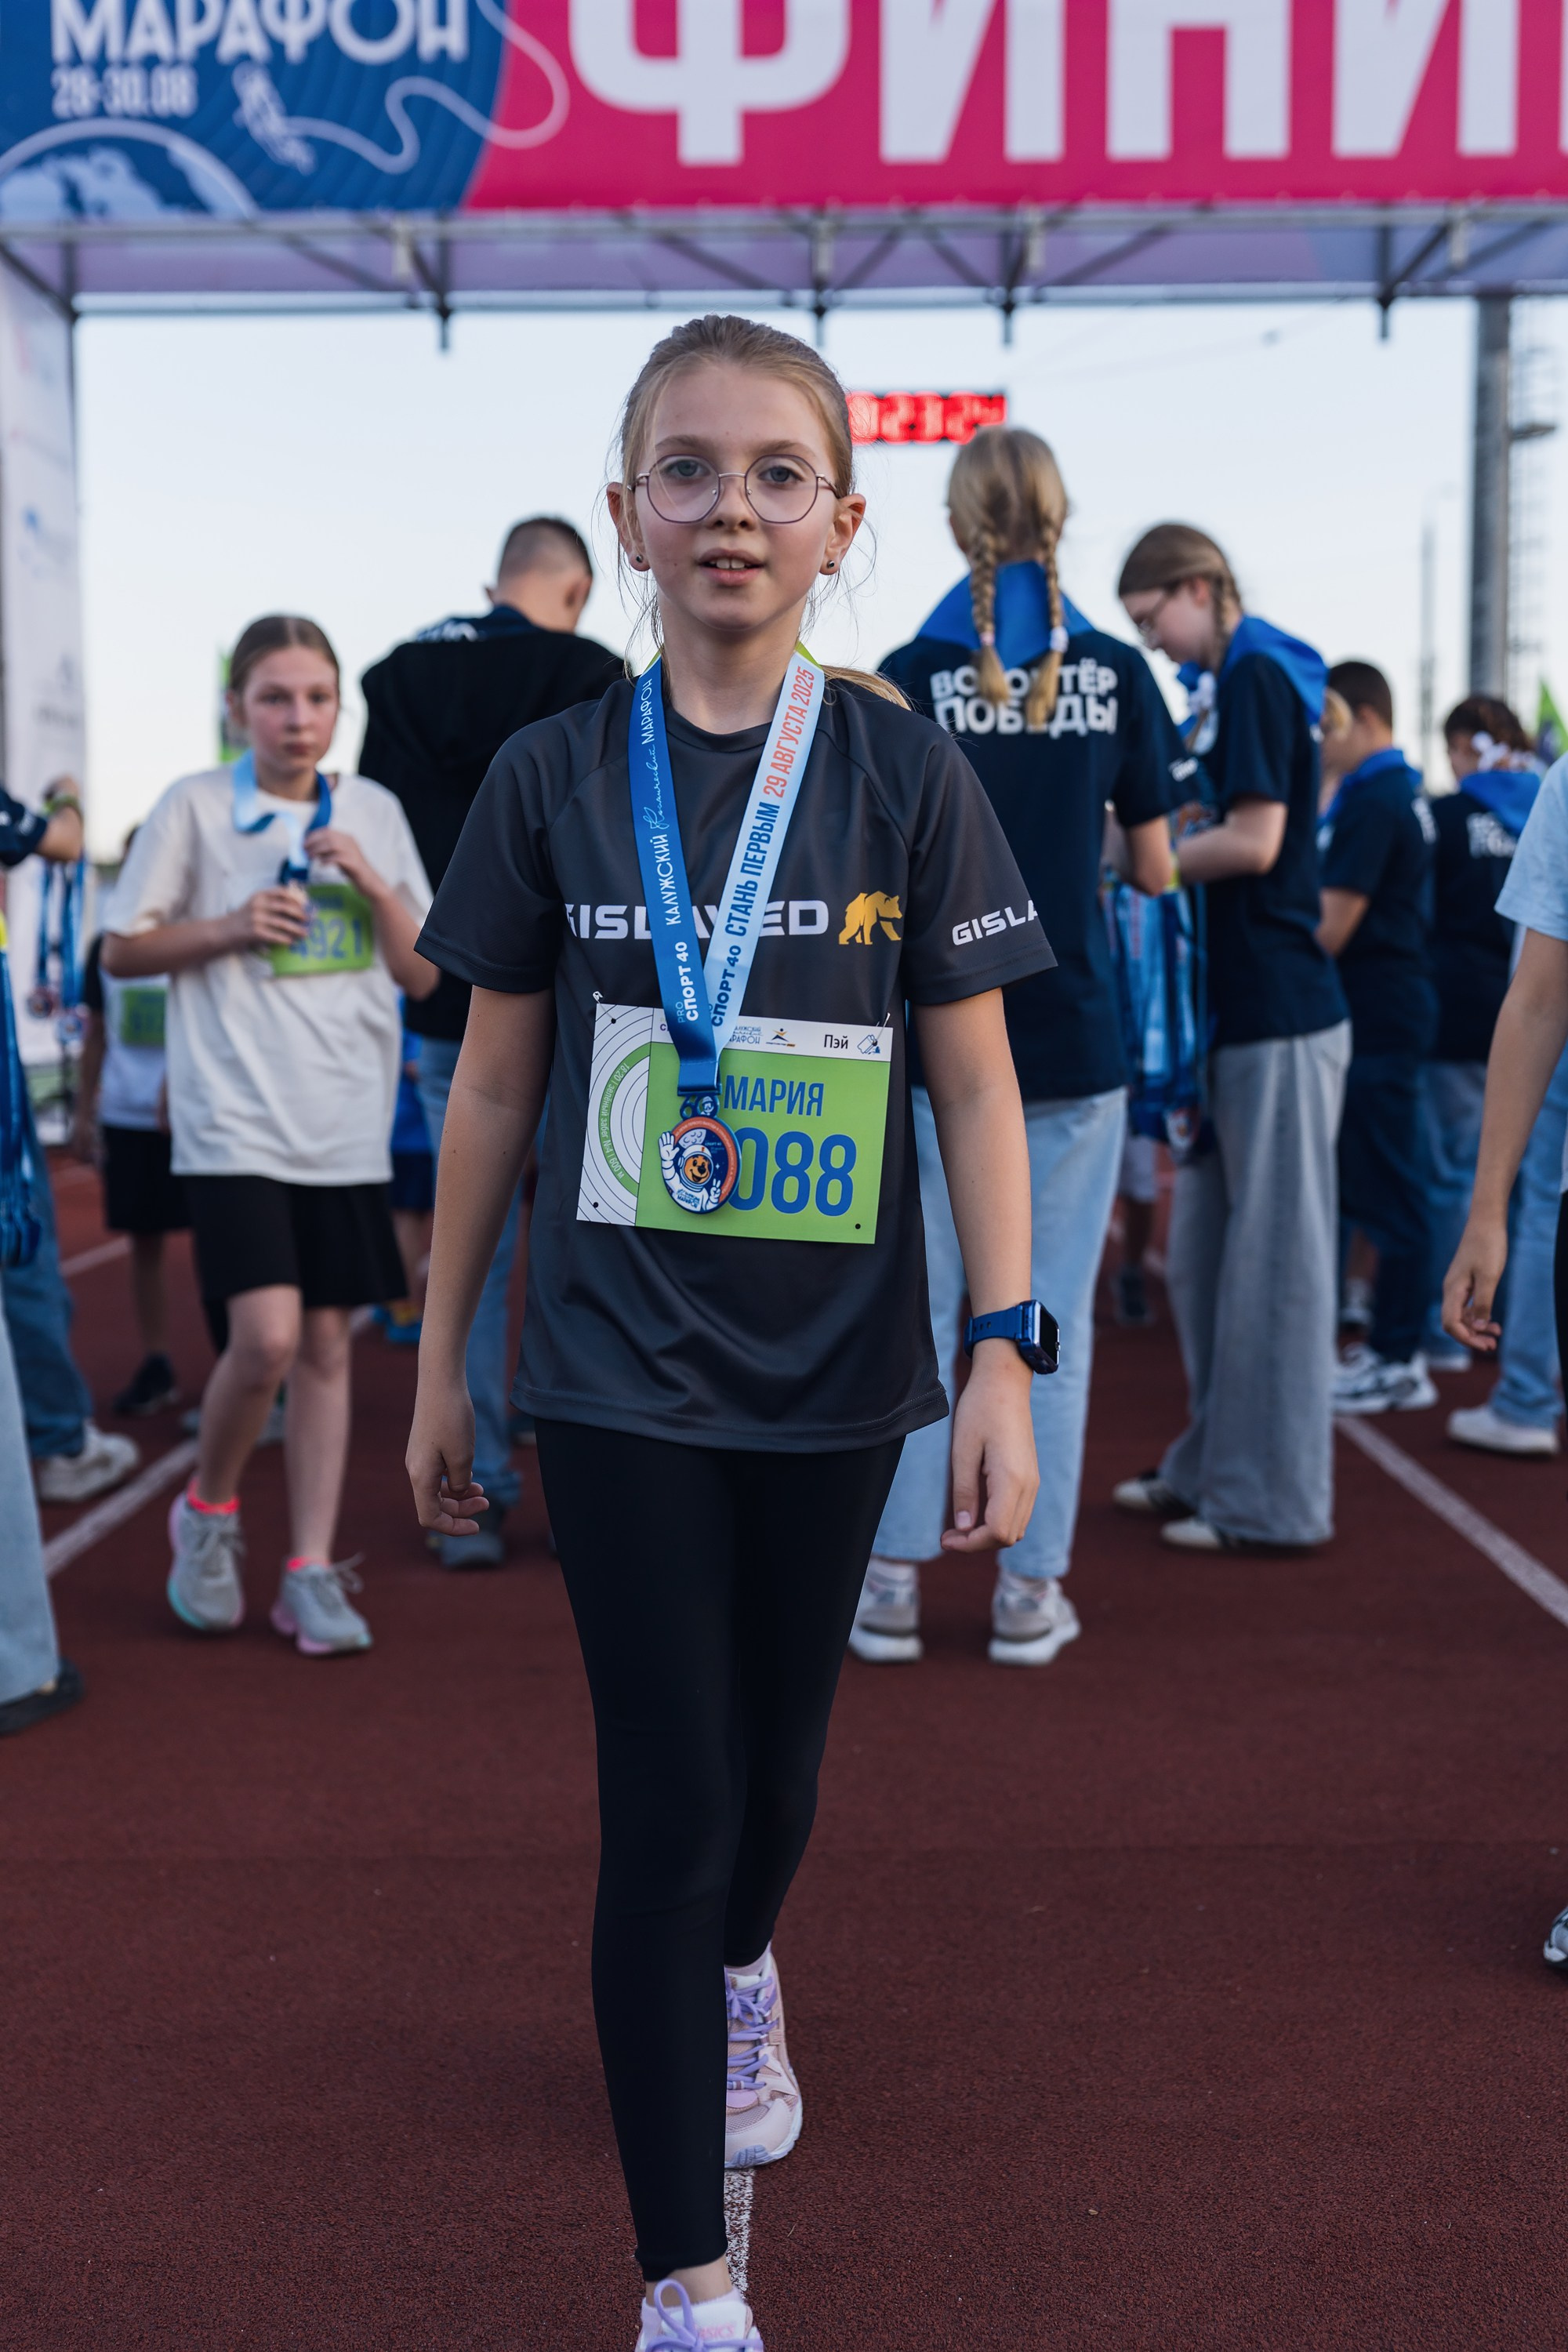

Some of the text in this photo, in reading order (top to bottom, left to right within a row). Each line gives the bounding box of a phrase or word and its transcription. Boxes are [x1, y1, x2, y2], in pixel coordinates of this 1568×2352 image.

[50, 0, 468, 64] МАРАФОН
[568, 0, 1568, 164] ФИНИ
[930, 657, 1118, 699] ВООТЁР
[640, 678, 655, 745] МАРАФОН
[934, 694, 1118, 739] ПОБДЫ
[711, 666, 815, 1026] СПОРТ 40 СТАНЬ ПЕРВЫМ 29 АВГУСТА 2025
[650, 833, 681, 926] КАЛУЖСКИЙ
[675, 942, 688, 962] 40
[675, 1001, 686, 1023] PRO
[678, 965, 699, 1022] СПОРТ
[824, 1034, 849, 1050] Пэй
[613, 1062, 630, 1082] 18:20
[601, 1083, 615, 1116] зелёный
[724, 1074, 824, 1116] МАРИЯ
[601, 1118, 610, 1138] забег
[609, 1157, 622, 1173] 600
